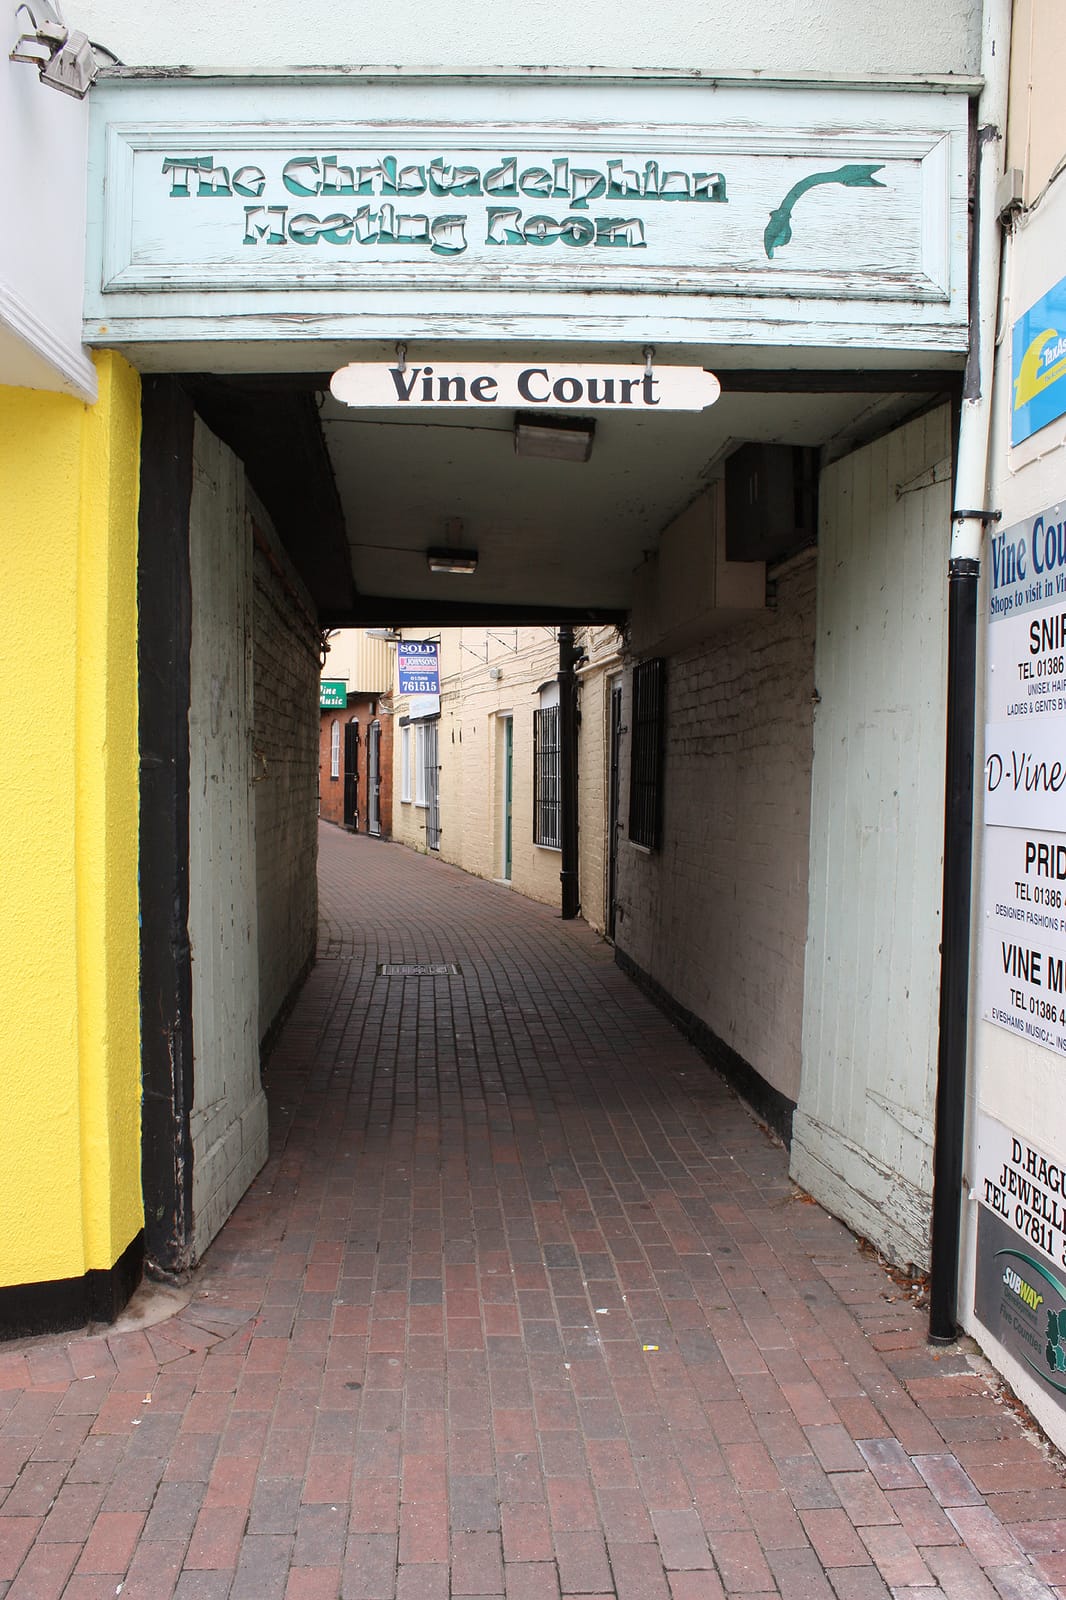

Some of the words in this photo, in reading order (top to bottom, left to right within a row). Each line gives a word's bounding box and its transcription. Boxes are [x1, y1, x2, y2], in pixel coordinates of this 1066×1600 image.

[162, 155, 266, 197] The
[283, 155, 729, 209] Christadelphian
[243, 203, 467, 256] Meeting
[485, 206, 647, 248] Room
[388, 366, 499, 402] Vine
[517, 368, 661, 405] Court
[991, 532, 1027, 589] Vine
[990, 595, 1013, 615] Shops
[1015, 590, 1023, 607] to
[1025, 581, 1042, 603] visit
[1045, 579, 1053, 597] in
[1056, 572, 1066, 593] Vi
[400, 644, 436, 654] SOLD
[1018, 661, 1035, 680] TEL
[1037, 656, 1064, 677] 01386
[402, 681, 437, 692] 761515
[1027, 681, 1050, 696] UNISEX
[1007, 702, 1028, 716] LADIES
[1029, 702, 1034, 713] &
[1035, 699, 1056, 713] GENTS
[986, 750, 1066, 792] D-Vine
[1015, 881, 1031, 902] TEL
[1034, 886, 1061, 909] 01386
[995, 904, 1025, 922] DESIGNER
[1026, 912, 1058, 931] FASHIONS
[1001, 941, 1042, 986] VINE
[1048, 956, 1066, 993] M
[992, 1008, 1025, 1032] EVESHAMS
[1010, 988, 1027, 1010] TEL
[1030, 996, 1057, 1023] 01386
[984, 1178, 1010, 1219] TEL
[1015, 1204, 1054, 1257] 07811
[1003, 1267, 1044, 1311] SUBWAY
[1013, 1317, 1042, 1355] Counties
